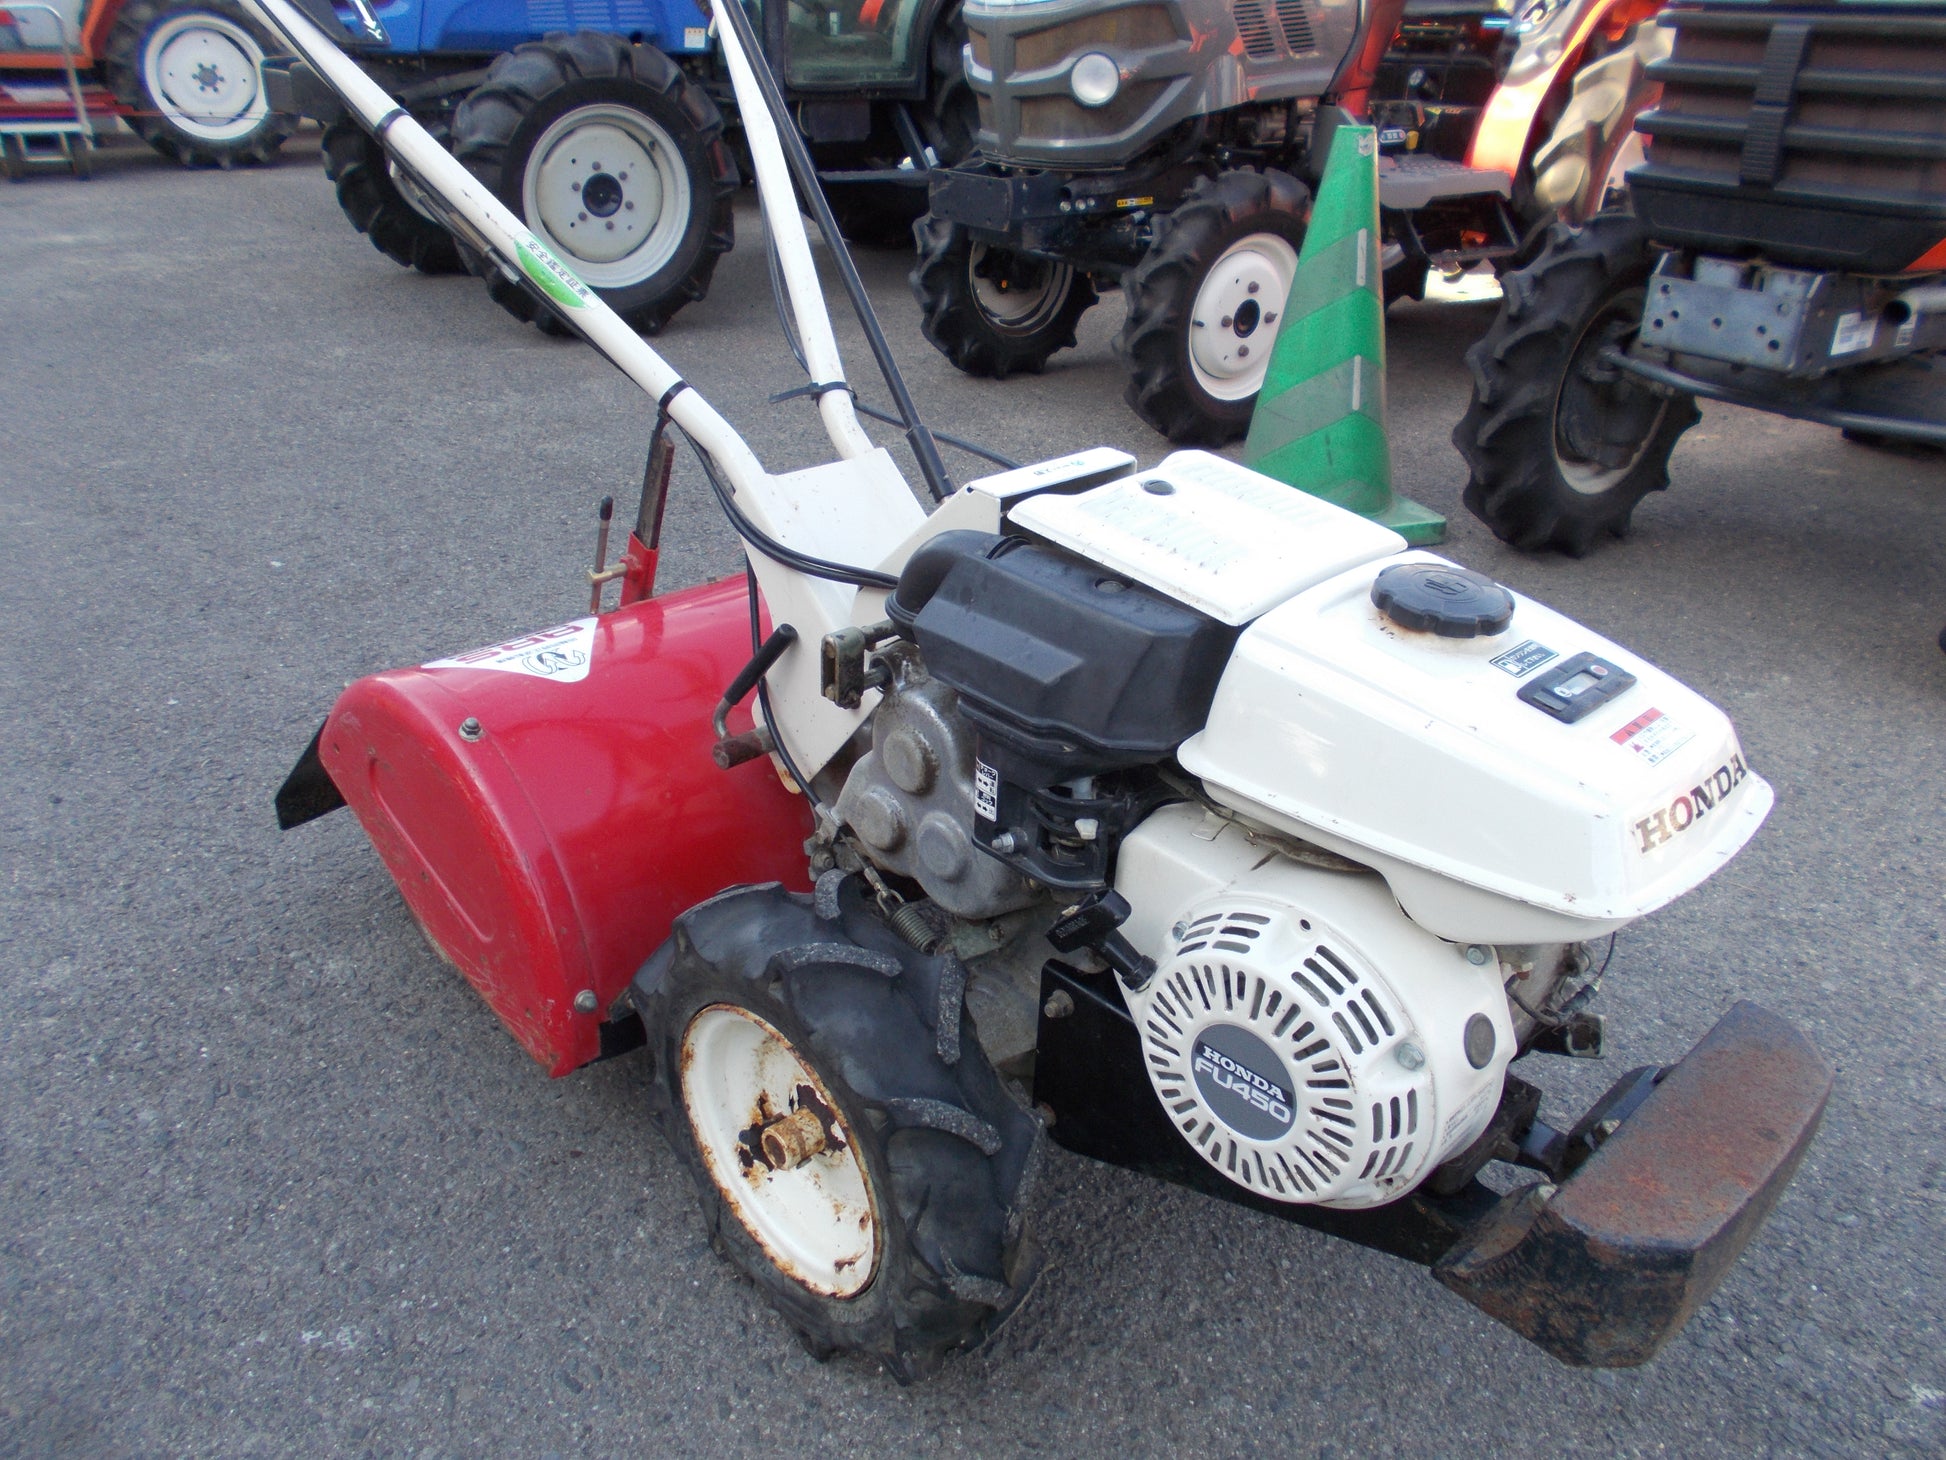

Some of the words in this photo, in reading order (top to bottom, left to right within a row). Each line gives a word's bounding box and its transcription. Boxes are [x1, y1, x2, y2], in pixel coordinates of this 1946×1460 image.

[1635, 753, 1747, 853] HONDA
[1194, 1057, 1291, 1124] FU450
[1203, 1046, 1286, 1103] HONDA
